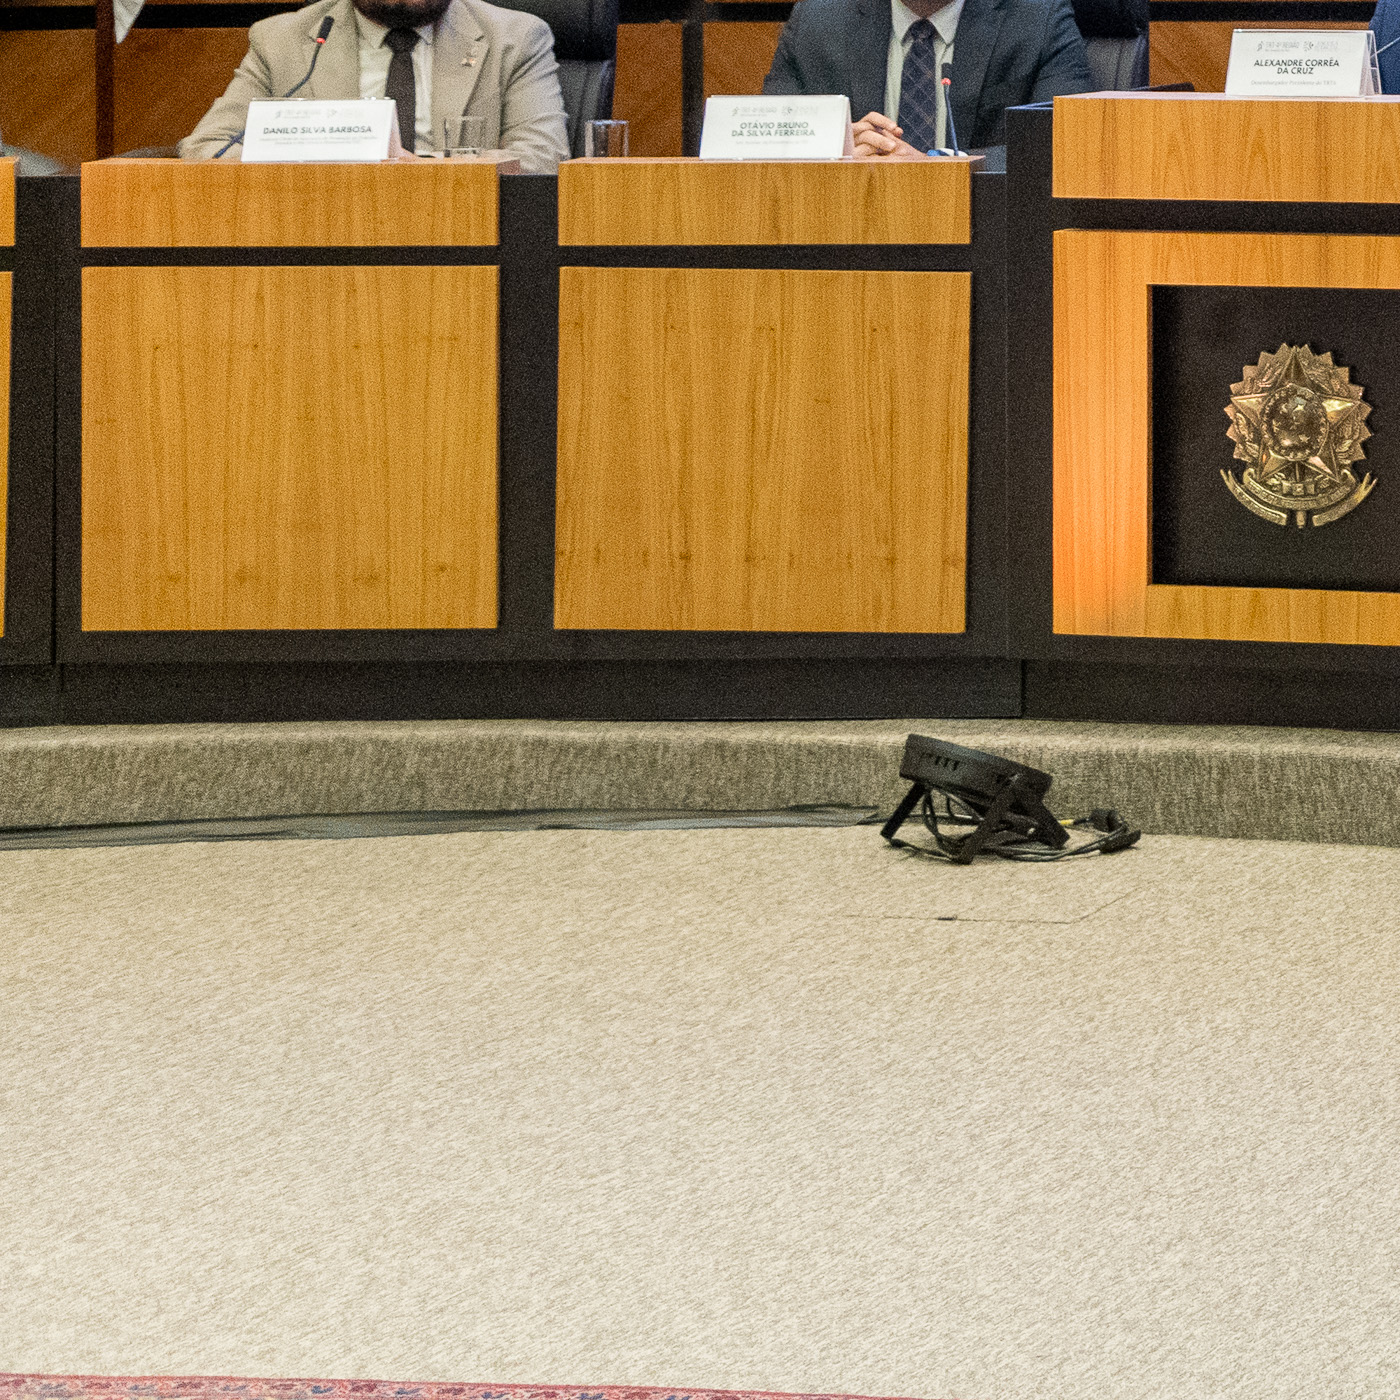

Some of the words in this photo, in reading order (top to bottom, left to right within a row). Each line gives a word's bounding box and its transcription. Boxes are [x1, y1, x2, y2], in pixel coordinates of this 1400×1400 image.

[1254, 59, 1303, 67] ALEXANDRE
[1305, 57, 1339, 67] CORRÊA
[740, 120, 775, 129] OTÁVIO
[777, 121, 809, 129] BRUNO
[263, 126, 298, 135] DANILO
[300, 126, 326, 134] SILVA
[328, 125, 372, 134] BARBOSA
[746, 129, 772, 137] SILVA
